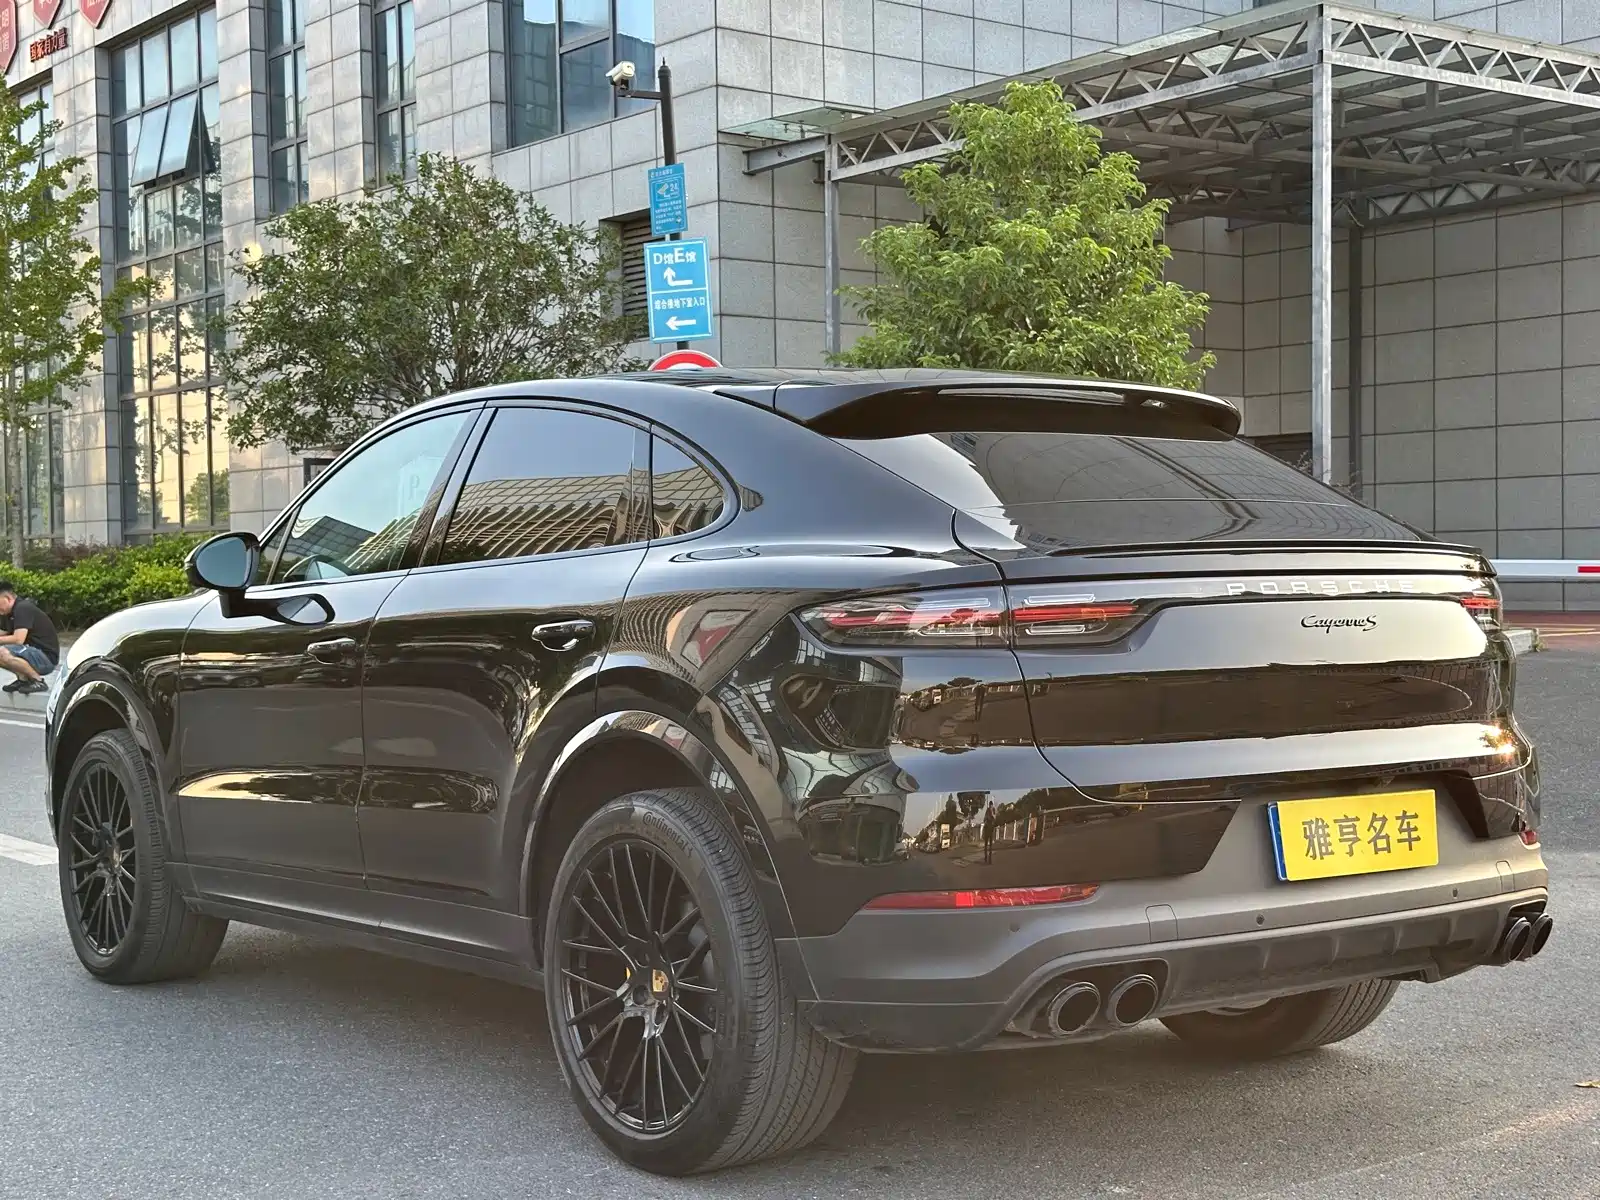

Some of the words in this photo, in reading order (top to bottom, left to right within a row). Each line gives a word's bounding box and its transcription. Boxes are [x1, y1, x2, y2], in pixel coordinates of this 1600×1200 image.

[1226, 580, 1415, 596] PORSCHE
[642, 810, 690, 850] Continental
[1301, 809, 1421, 861] 雅亨名车
